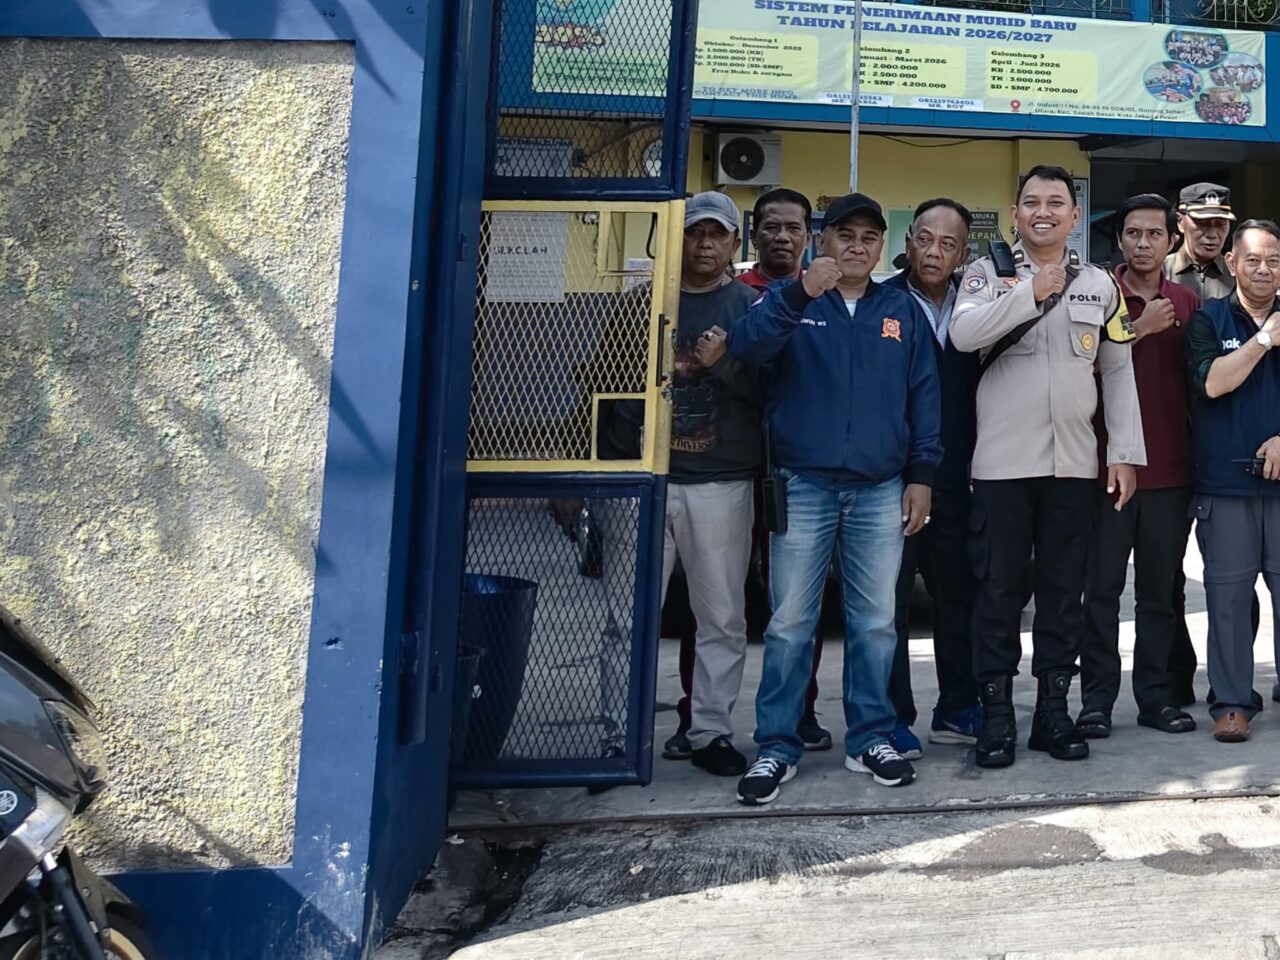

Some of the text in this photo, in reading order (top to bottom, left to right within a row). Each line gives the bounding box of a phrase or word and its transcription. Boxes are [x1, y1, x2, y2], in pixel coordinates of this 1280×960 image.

[754, 0, 1077, 32] SISTEM PENERIMAAN MURID BARU
[776, 15, 846, 29] TAHUN
[964, 28, 1054, 43] 2026/2027
[860, 46, 903, 55] elombang
[990, 50, 1038, 60] Gelombang
[895, 55, 922, 63] Maret
[990, 58, 1013, 66] April
[1039, 61, 1061, 69] 2026
[872, 63, 919, 71] 2.000.000
[1009, 67, 1052, 76] 2.500.000
[872, 71, 918, 79] 2.500.000
[901, 81, 947, 89] 4.200.000
[1069, 293, 1101, 304] POLRI
